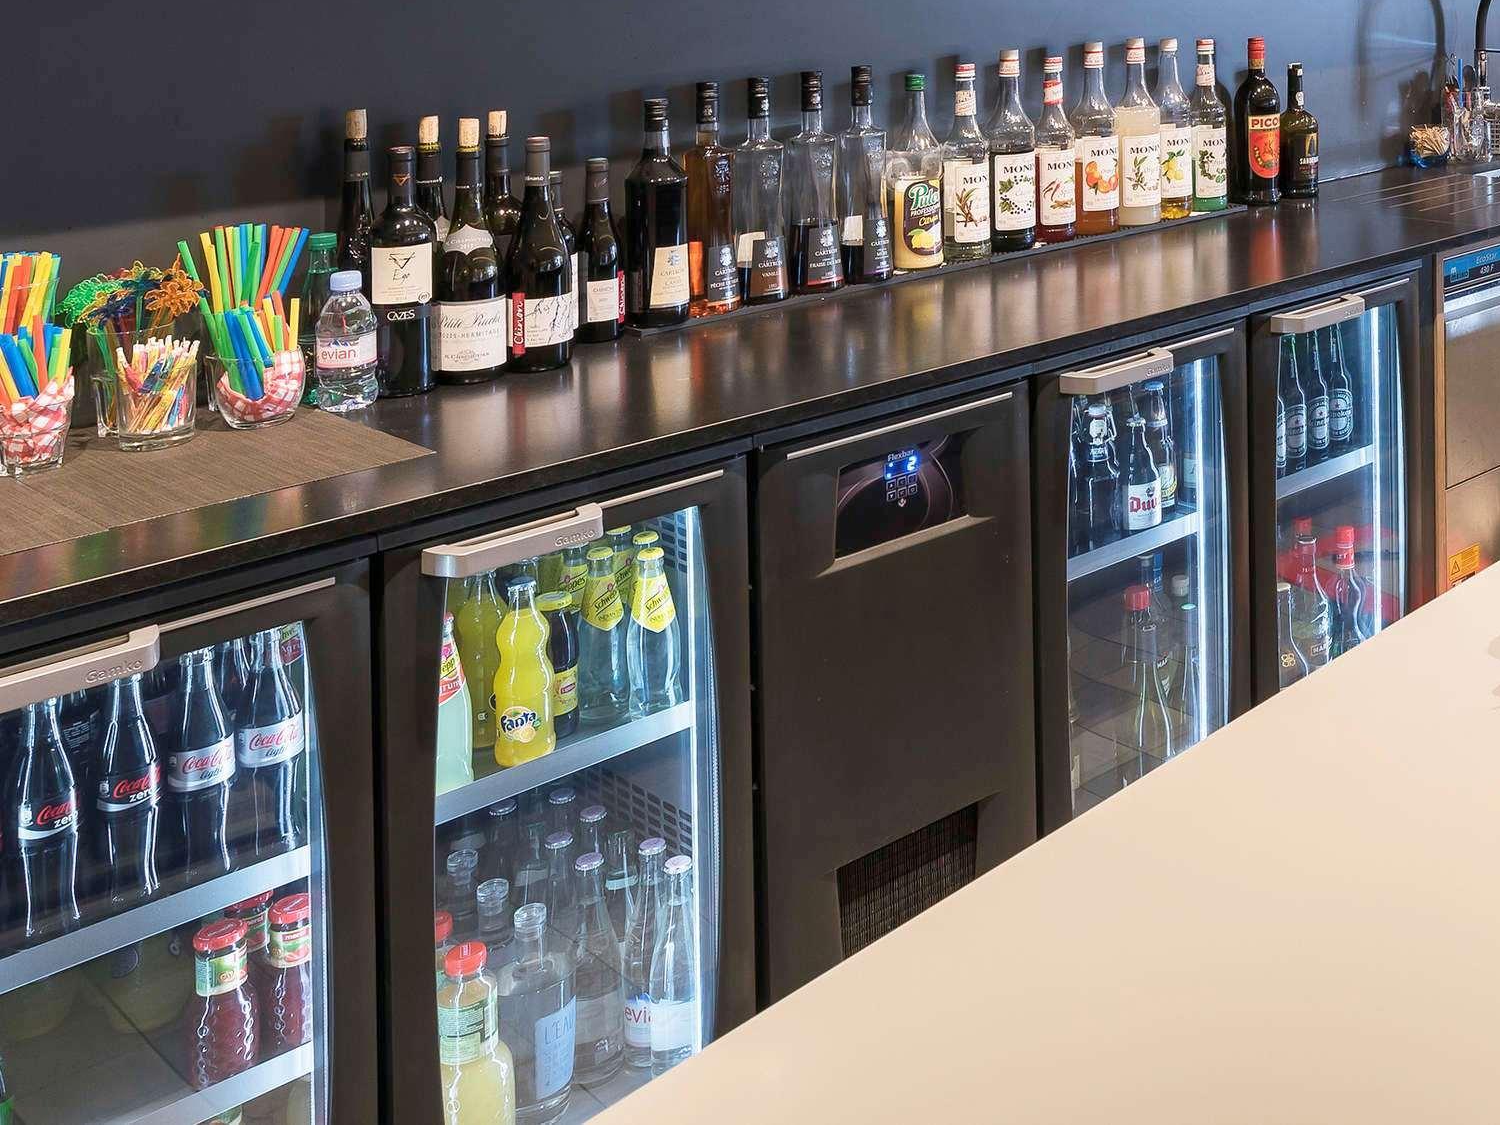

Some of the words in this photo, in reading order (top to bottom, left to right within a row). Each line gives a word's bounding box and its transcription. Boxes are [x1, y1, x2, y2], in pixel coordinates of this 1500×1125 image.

[387, 309, 415, 321] CAZES
[513, 301, 524, 345] Chinon
[321, 347, 356, 361] evian
[500, 711, 537, 733] fanta
